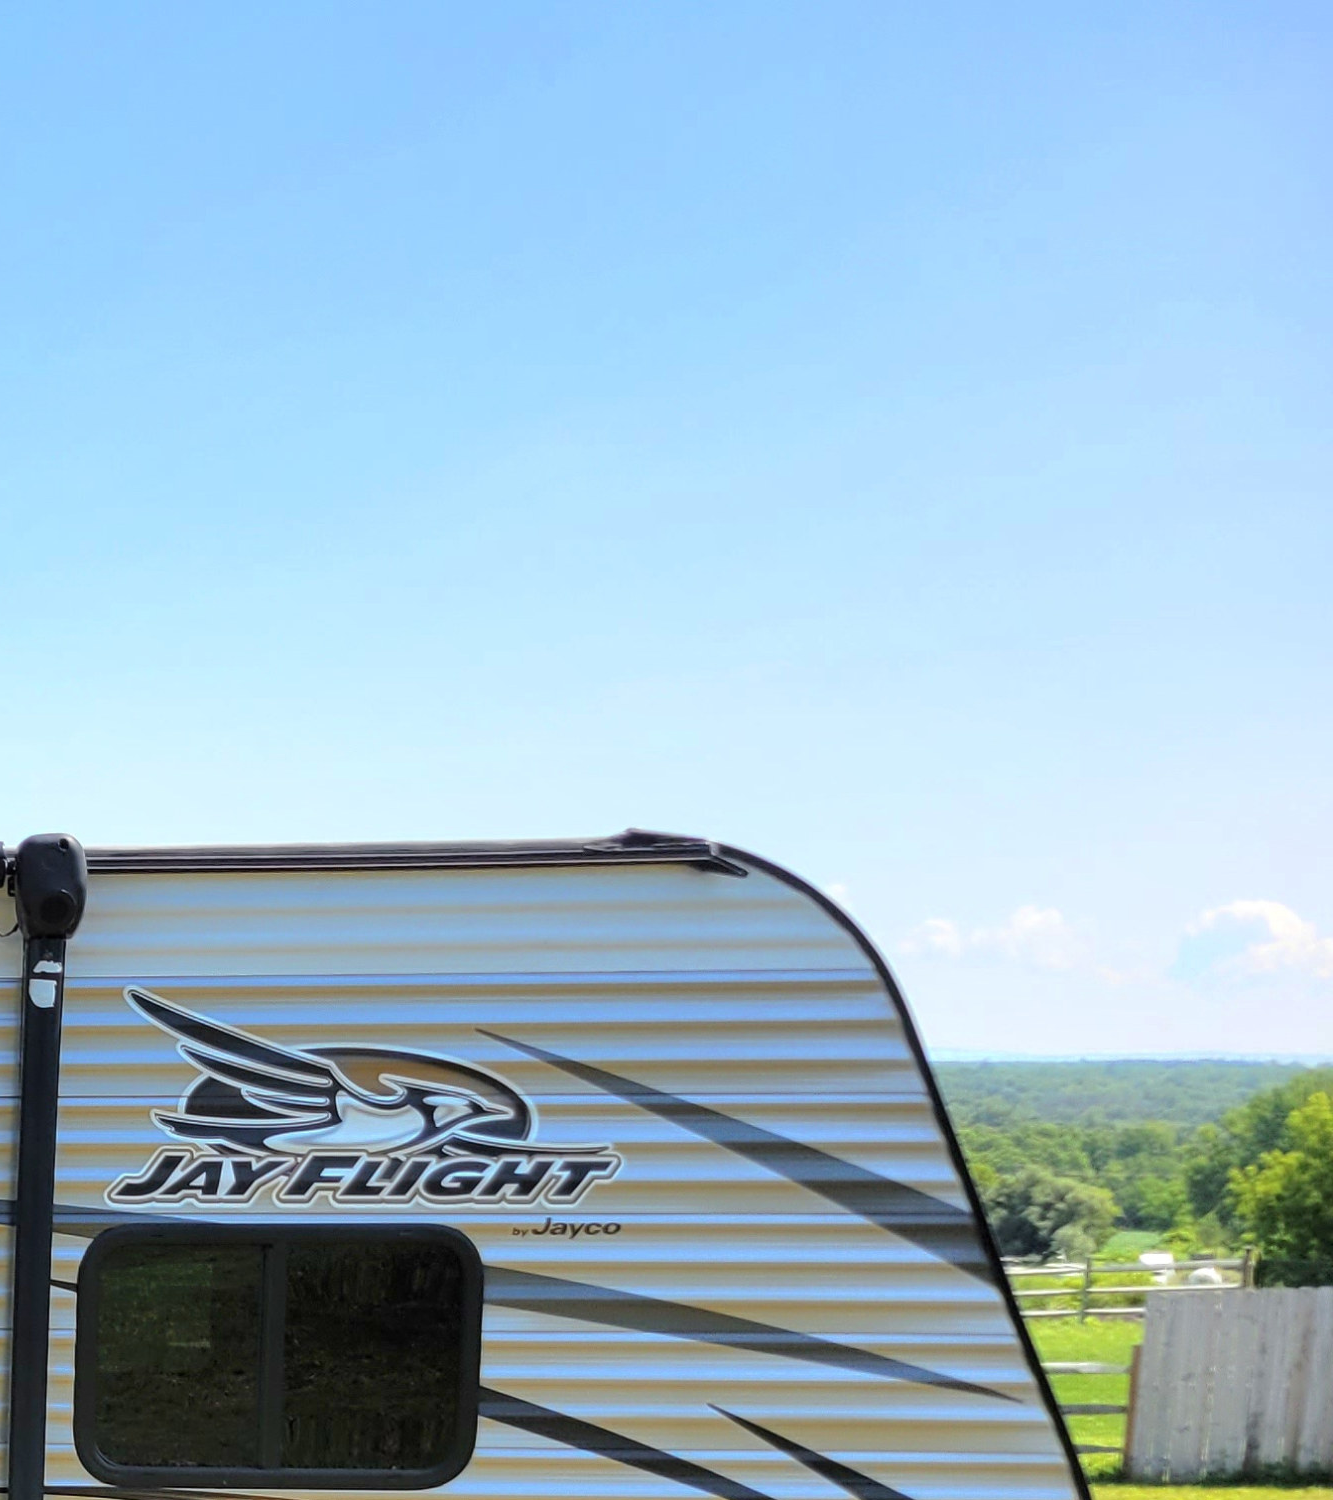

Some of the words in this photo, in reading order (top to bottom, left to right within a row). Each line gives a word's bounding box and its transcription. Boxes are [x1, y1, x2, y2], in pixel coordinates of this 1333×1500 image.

[109, 1147, 293, 1203] JAY
[278, 1147, 620, 1203] FLIGHT
[512, 1227, 529, 1237] by
[531, 1217, 621, 1240] Jayco
